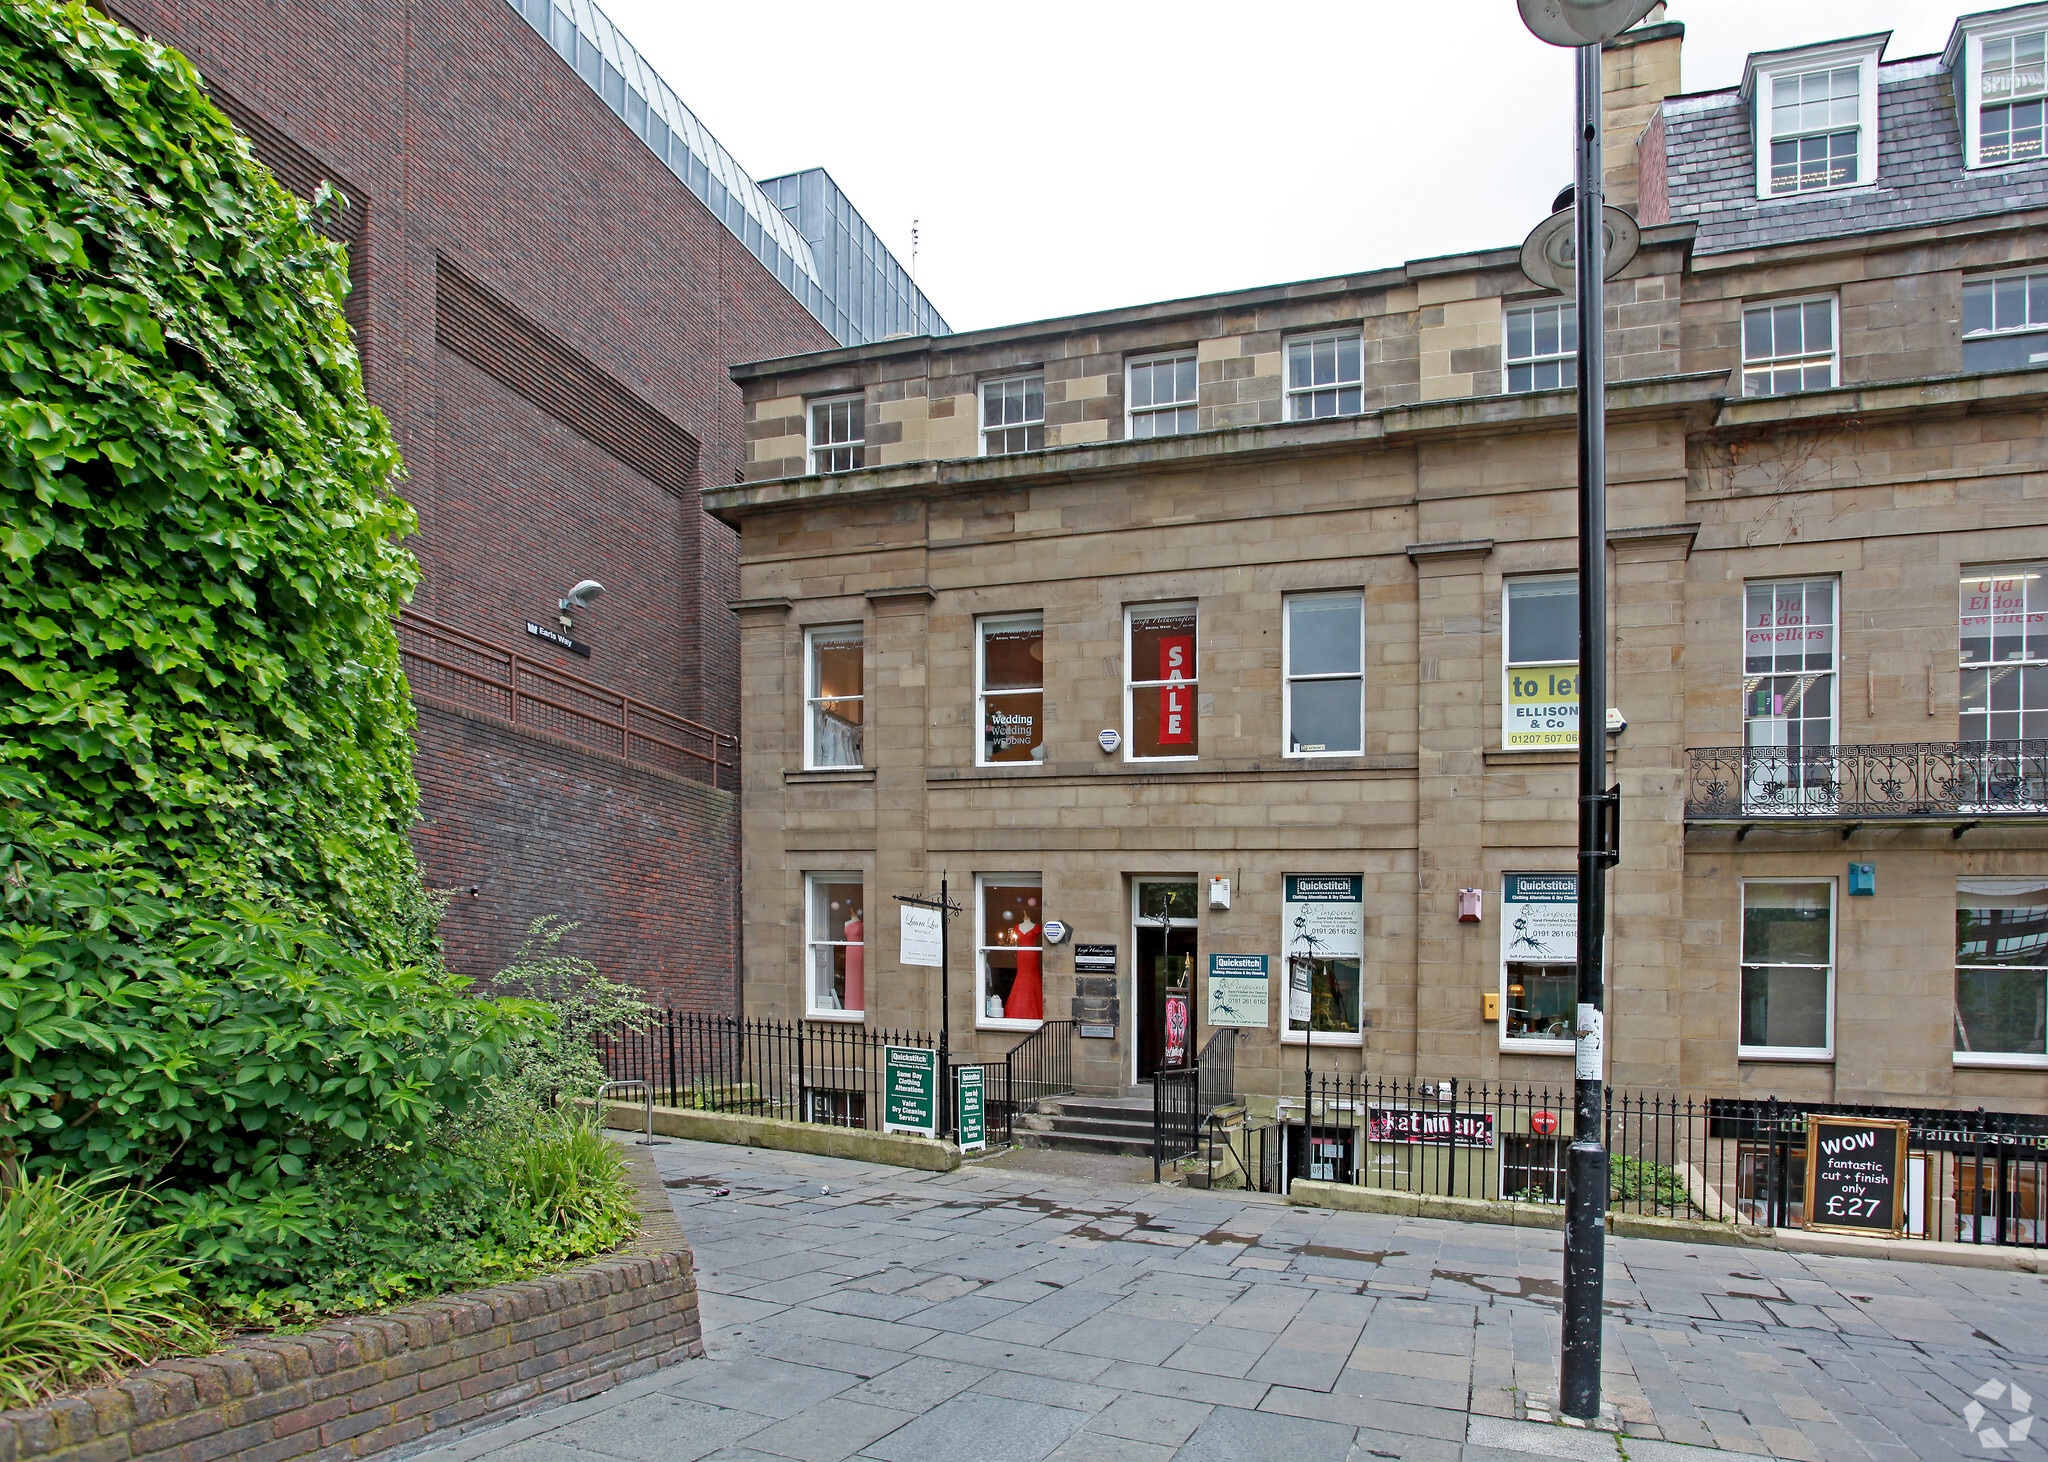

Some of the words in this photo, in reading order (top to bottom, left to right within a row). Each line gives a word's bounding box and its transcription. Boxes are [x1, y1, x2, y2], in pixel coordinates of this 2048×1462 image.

[1770, 598, 1801, 612] Old
[539, 627, 557, 640] Earls
[557, 634, 573, 648] Way
[1166, 646, 1186, 735] SALE
[1513, 676, 1538, 697] to
[1516, 706, 1579, 717] ELLISON
[991, 715, 1033, 726] Wedding
[1530, 719, 1540, 728] &
[1546, 719, 1565, 728] Co
[991, 725, 1032, 737] Wedding
[993, 737, 1031, 745] WEDDING
[1511, 735, 1540, 743] 01207
[1544, 734, 1562, 743] 507
[1565, 734, 1579, 742] 06
[1300, 881, 1348, 891] Quickstitch
[1520, 881, 1574, 891] Quickstitch
[1167, 891, 1177, 904] 7
[1218, 959, 1260, 967] Quickstitch
[893, 1053, 927, 1063] Quickstitch
[912, 1071, 922, 1079] Day
[899, 1078, 921, 1087] Clothing
[895, 1085, 924, 1094] Alterations
[902, 1107, 927, 1117] Cleaning
[899, 1114, 919, 1122] Service
[1821, 1131, 1875, 1155] WOW
[1827, 1158, 1883, 1171] fantastic
[1821, 1172, 1841, 1180] cut
[1855, 1172, 1889, 1184] finish
[1841, 1184, 1866, 1196] only
[1825, 1195, 1881, 1218] £27
